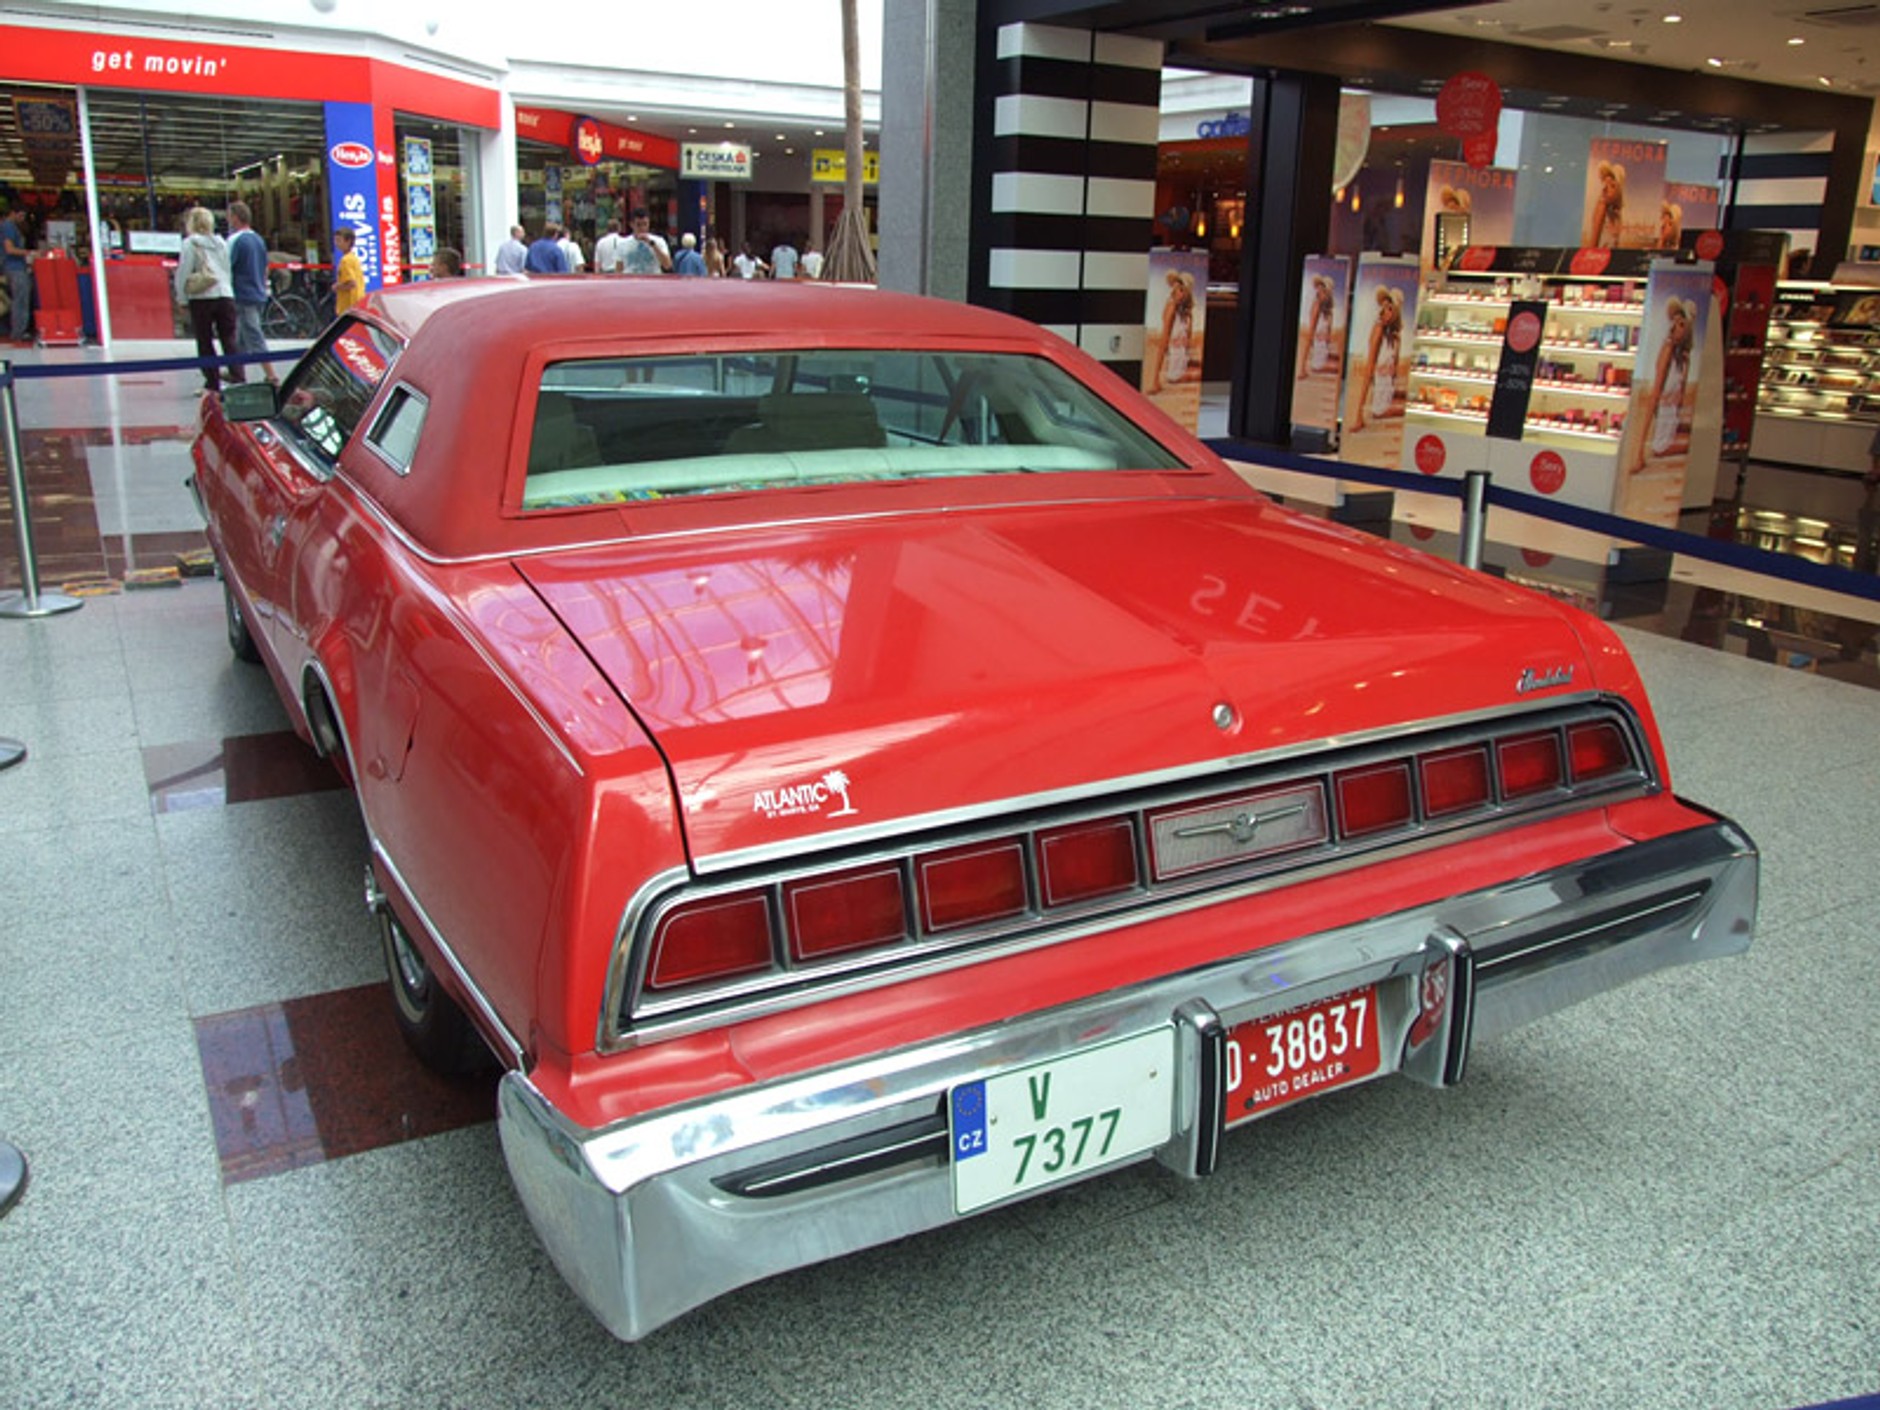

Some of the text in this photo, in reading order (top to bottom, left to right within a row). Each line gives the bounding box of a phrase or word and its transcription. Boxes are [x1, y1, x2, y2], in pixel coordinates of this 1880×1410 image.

[92, 50, 227, 77] get movin'
[753, 782, 828, 812] ATLANTIC
[1028, 1071, 1051, 1121] V
[1252, 1061, 1344, 1103] AUTO DEALER
[958, 1129, 983, 1152] CZ
[1013, 1107, 1122, 1185] 7377
